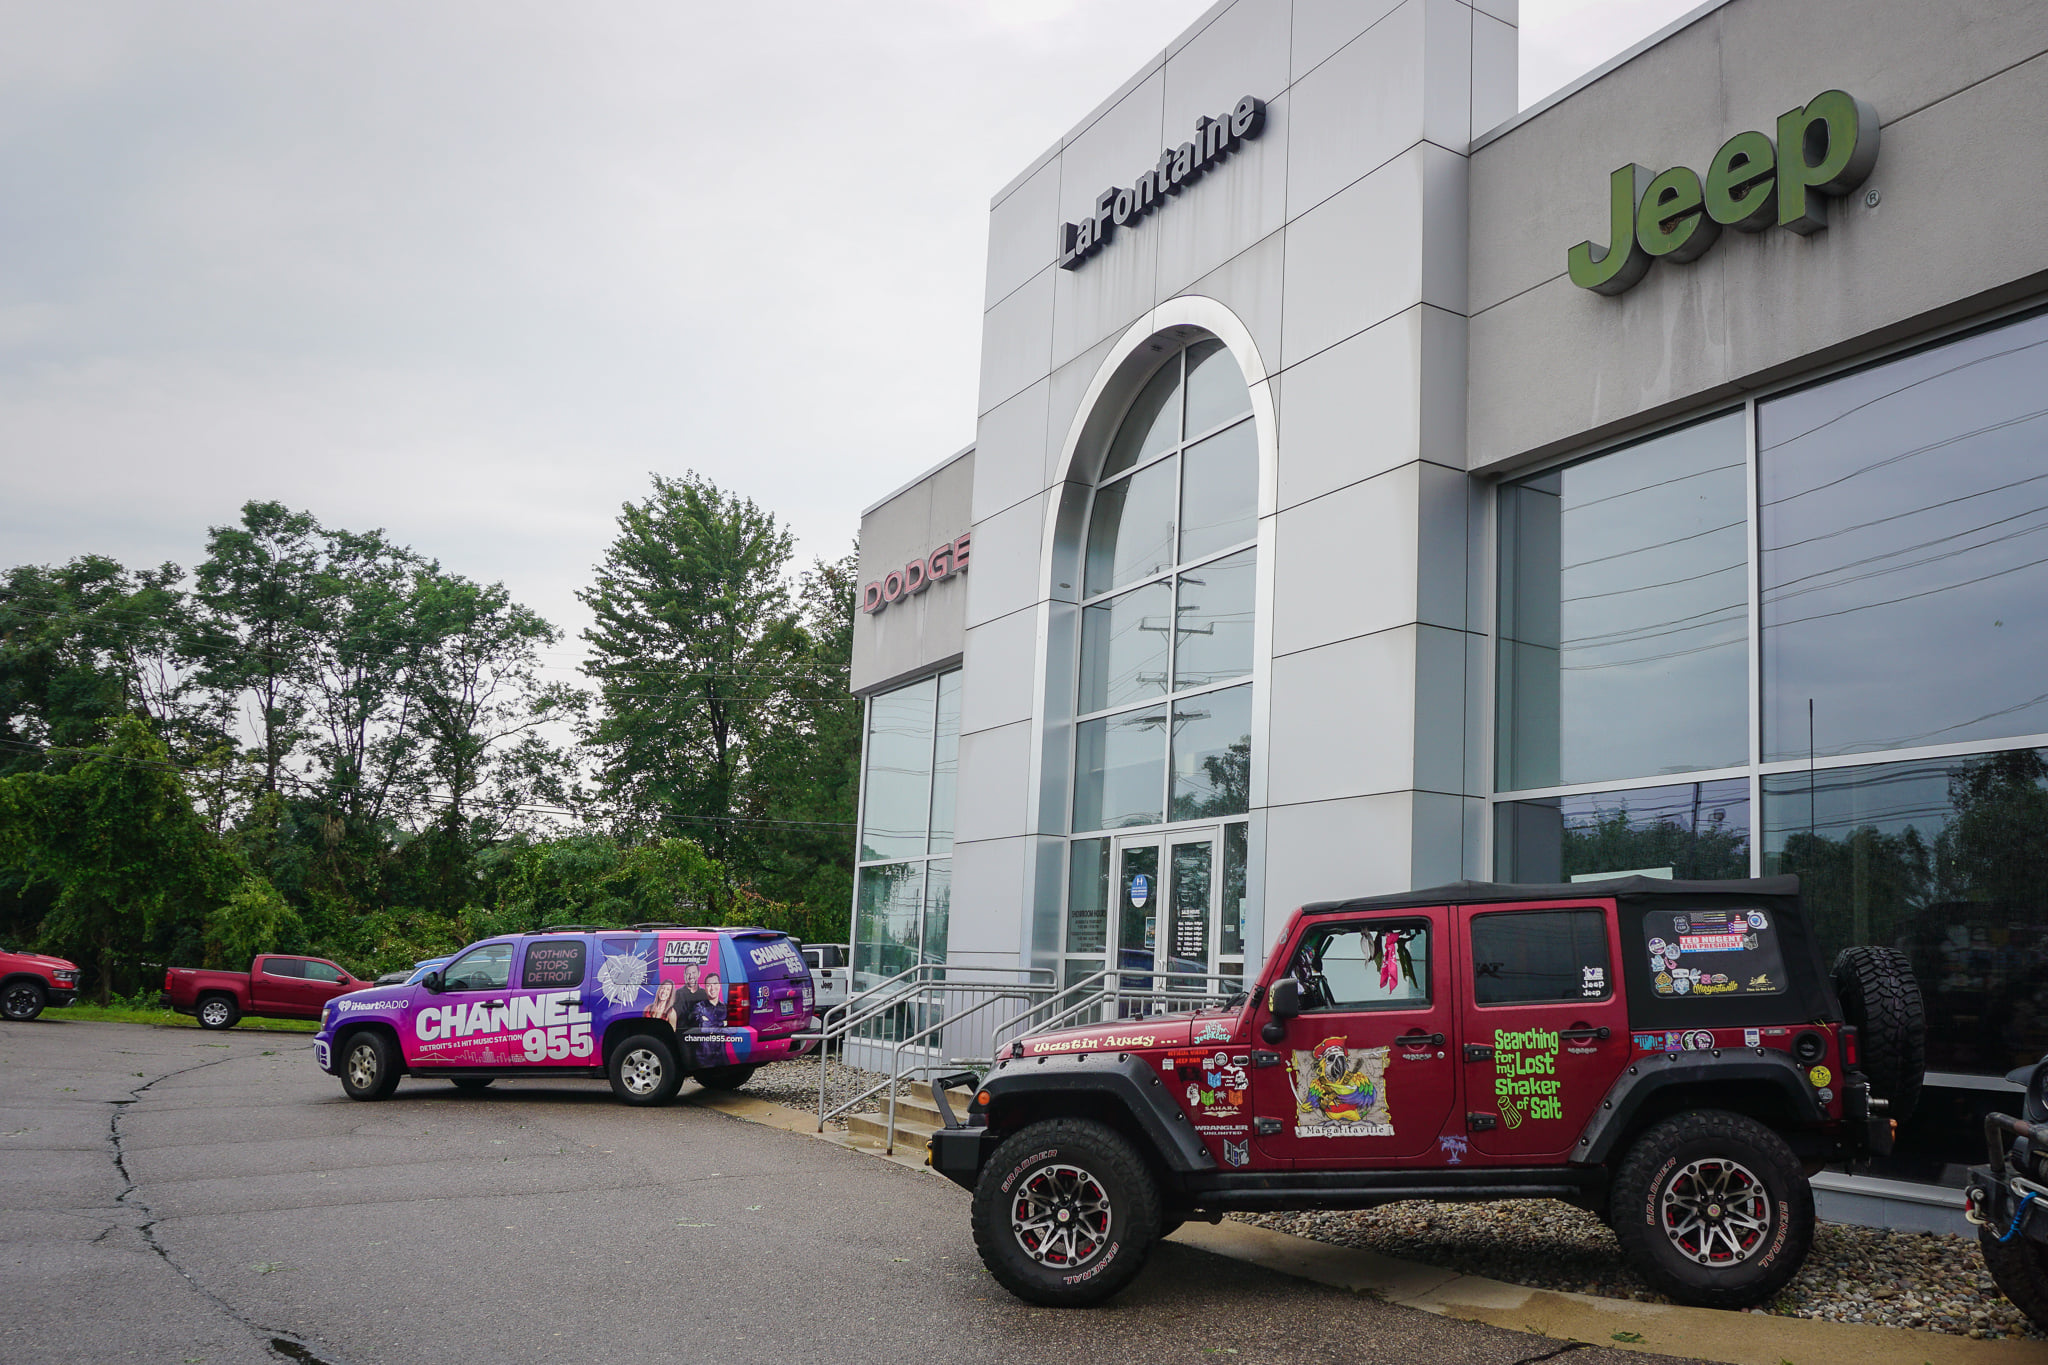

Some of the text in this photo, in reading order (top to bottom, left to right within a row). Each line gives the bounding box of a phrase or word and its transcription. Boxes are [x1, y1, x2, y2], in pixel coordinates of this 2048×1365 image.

[1059, 94, 1266, 271] LaFontaine
[1568, 90, 1872, 293] Jeep
[863, 532, 971, 614] DODGE
[666, 941, 709, 956] MOJO
[1681, 935, 1741, 944] TED NUGENT
[530, 948, 579, 960] NOTHING
[750, 943, 796, 966] CHANNEL
[535, 960, 569, 971] STOPS
[784, 956, 803, 974] 955
[527, 971, 573, 982] DETROIT
[821, 980, 833, 990] Jeep
[1582, 981, 1605, 989] Jeep
[1583, 989, 1601, 997] Jeep
[351, 1000, 409, 1011] iHeartRADIO
[416, 990, 592, 1041] CHANNEL
[420, 1042, 452, 1052] DETROIT'S
[462, 1039, 472, 1047] HIT
[473, 1037, 493, 1046] MUSIC
[494, 1034, 522, 1043] STATION
[522, 1023, 593, 1062] 955
[684, 1034, 743, 1043] channel955.com
[1103, 1035, 1156, 1047] Away
[1494, 1028, 1559, 1055] Searching
[1494, 1050, 1555, 1075] for Lost
[1496, 1064, 1515, 1077] my
[1495, 1077, 1561, 1095] Shaker
[1516, 1095, 1562, 1119] of Salt
[1306, 1126, 1384, 1136] Margaritaville
[1001, 1150, 1058, 1193] GRABBER
[1646, 1157, 1677, 1226] GRABBER
[1758, 1201, 1789, 1268] GENERAL
[1063, 1242, 1119, 1284] GENERAL
